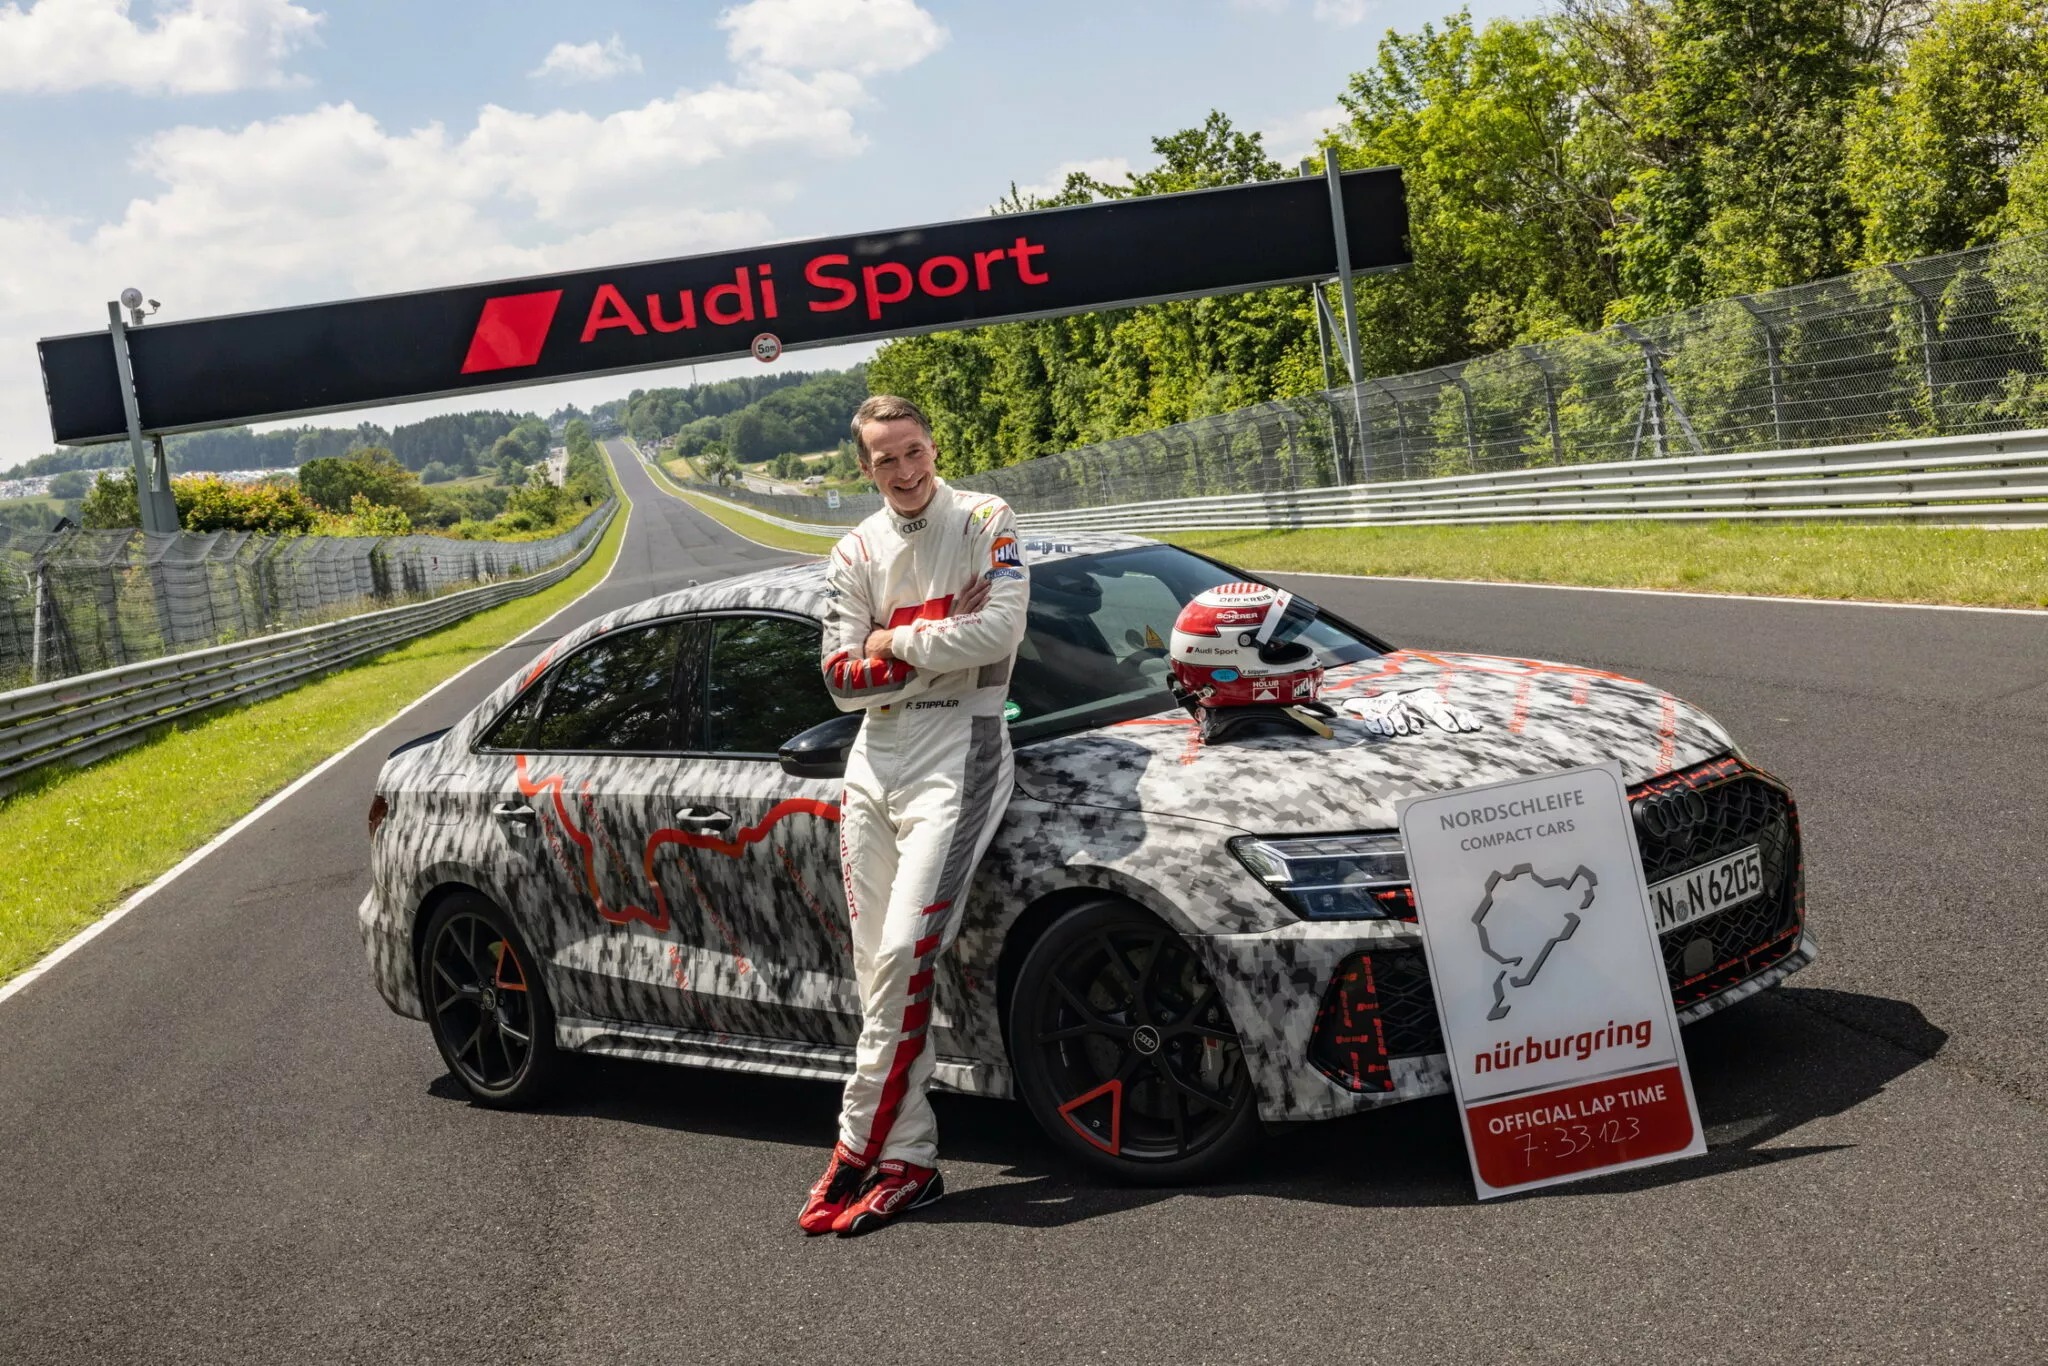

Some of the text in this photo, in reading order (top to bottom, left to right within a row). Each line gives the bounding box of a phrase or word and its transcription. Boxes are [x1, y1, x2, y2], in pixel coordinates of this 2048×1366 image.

[580, 237, 1049, 343] Audi Sport
[1216, 612, 1258, 620] SCHERER
[1243, 594, 1271, 602] KREIS
[1214, 648, 1239, 656] Sport
[916, 699, 959, 710] STIPPLER
[1253, 680, 1279, 688] HOLUB
[1440, 789, 1585, 831] NORDSCHLEIFE
[840, 813, 849, 858] Audi
[1460, 818, 1575, 852] COMPACT CARS
[844, 863, 859, 920] Sport
[1709, 853, 1760, 906] 6205
[1474, 1020, 1652, 1074] nürburgring
[1488, 1085, 1667, 1135] OFFICIAL LAP TIME
